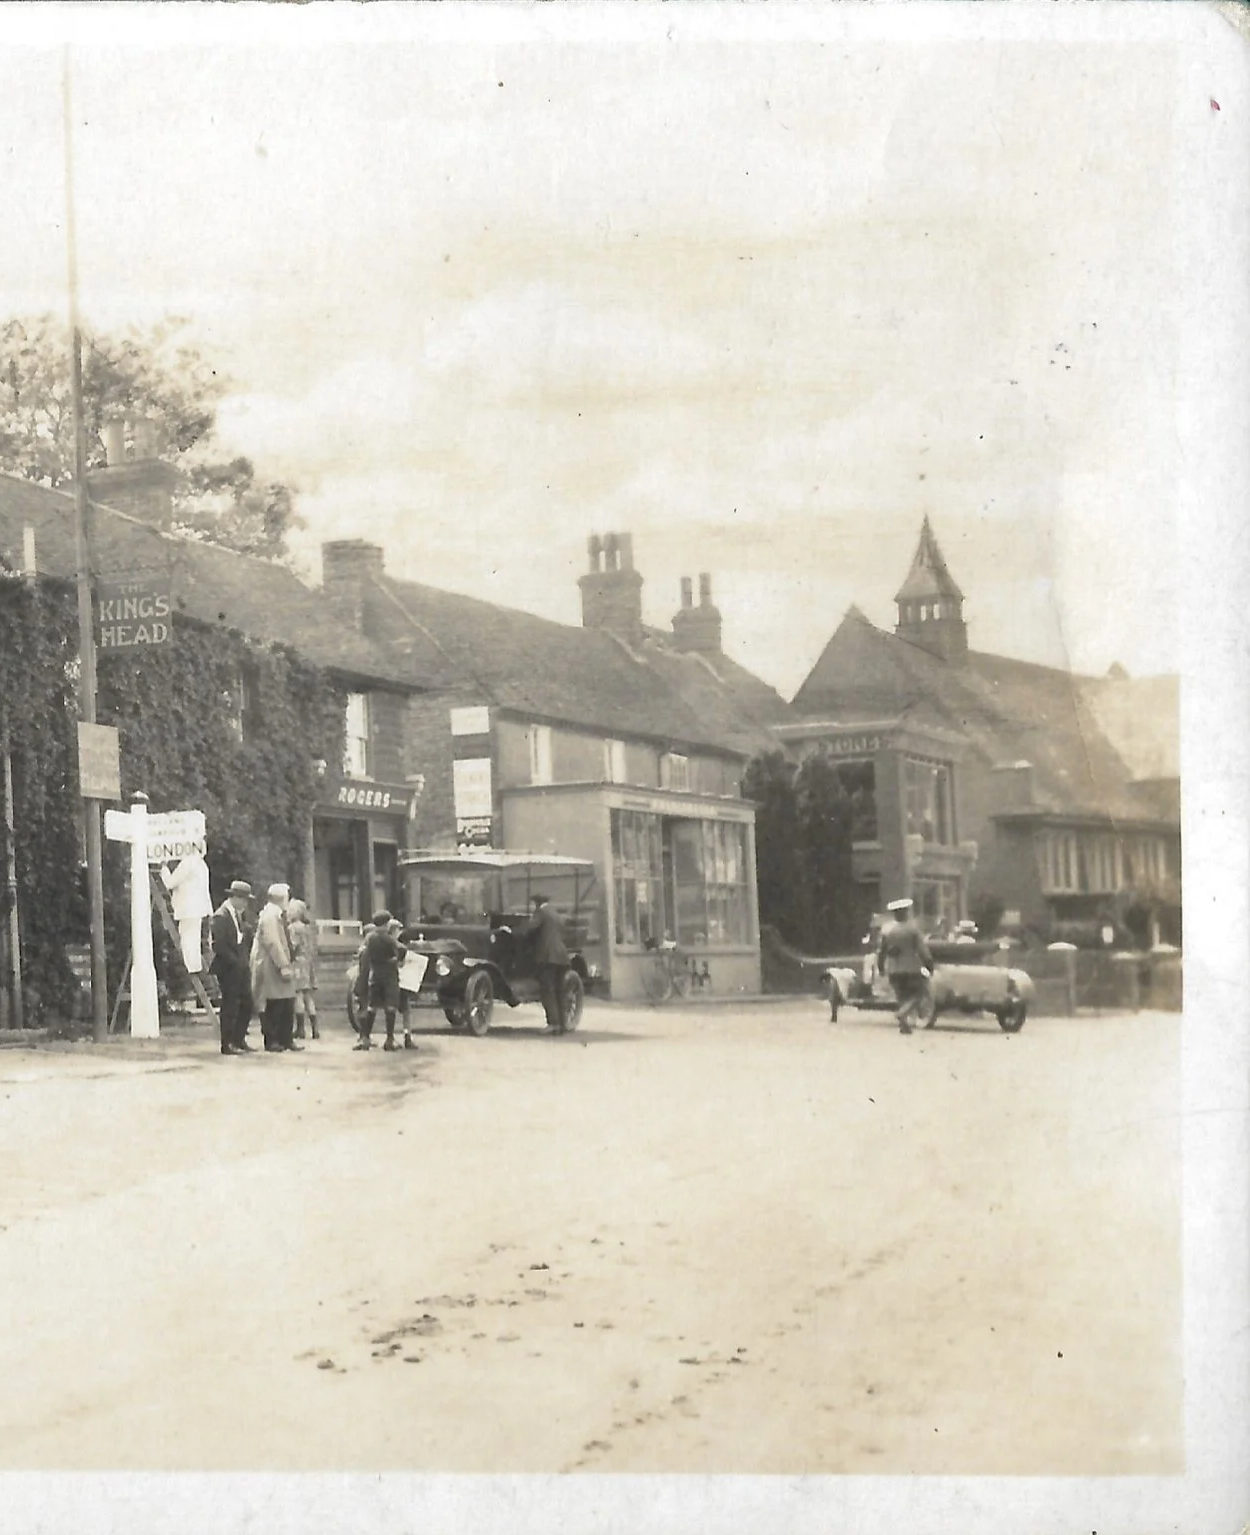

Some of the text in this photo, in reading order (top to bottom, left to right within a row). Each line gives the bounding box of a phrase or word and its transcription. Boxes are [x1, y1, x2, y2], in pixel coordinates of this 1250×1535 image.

[118, 583, 149, 595] THE
[101, 623, 168, 648] HEAD
[338, 786, 391, 809] ROGERS
[146, 841, 203, 859] LONDON
